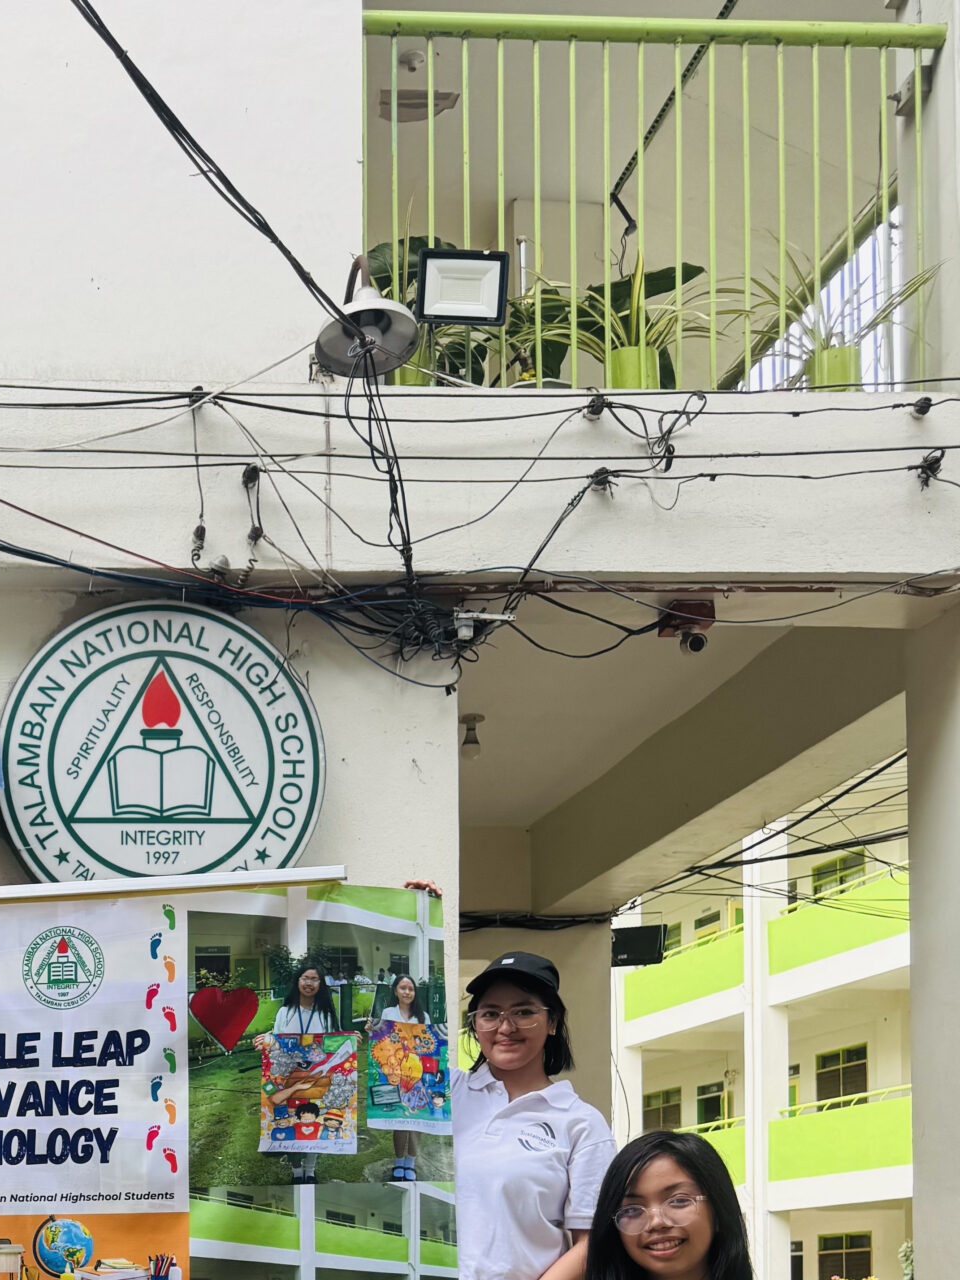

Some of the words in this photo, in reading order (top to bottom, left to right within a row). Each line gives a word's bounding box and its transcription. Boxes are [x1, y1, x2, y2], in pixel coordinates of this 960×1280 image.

[17, 675, 65, 850] TALAMBAN
[59, 619, 210, 679] NATIONAL
[217, 638, 286, 707] HIGH
[260, 712, 305, 841] SCHOOL
[66, 674, 132, 780] SPIRITUALITY
[185, 672, 260, 789] RESPONSIBILITY
[120, 829, 206, 847] INTEGRITY
[145, 851, 180, 865] 1997
[24, 940, 40, 982] TALAMBAN
[38, 928, 76, 942] NATIONAL
[77, 932, 95, 946] HIGH
[92, 946, 103, 979] SCHOOL
[34, 991, 62, 1007] TALAMBAN
[52, 1029, 151, 1067] LEAP
[9, 1193, 57, 1203] National
[60, 1192, 122, 1204] Highschool
[124, 1190, 175, 1201] Students
